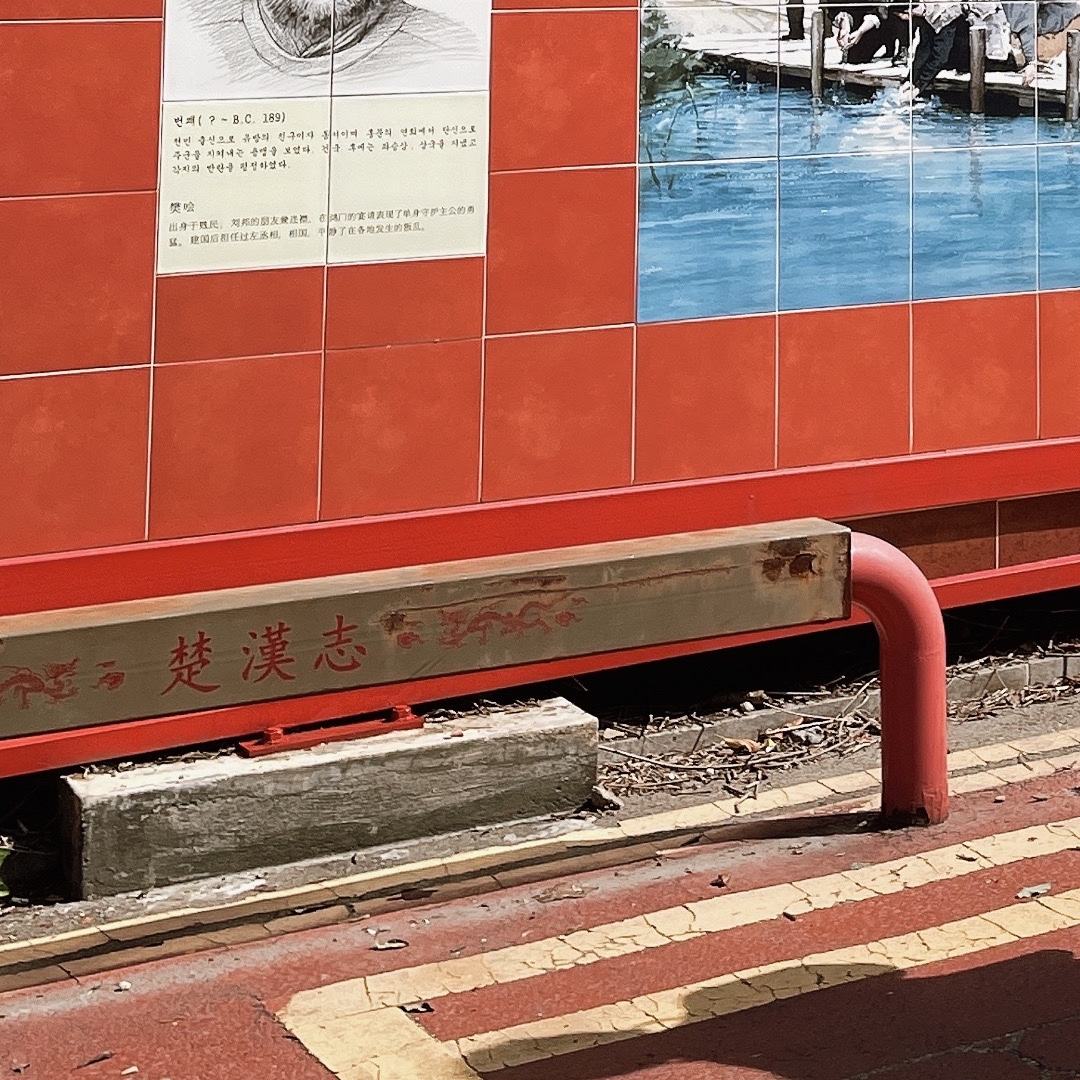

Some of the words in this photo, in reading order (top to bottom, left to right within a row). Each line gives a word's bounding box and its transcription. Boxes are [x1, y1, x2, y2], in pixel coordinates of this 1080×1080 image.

[207, 115, 216, 126] ?
[262, 111, 286, 124] 189)
[161, 614, 368, 696] 楚漢志
